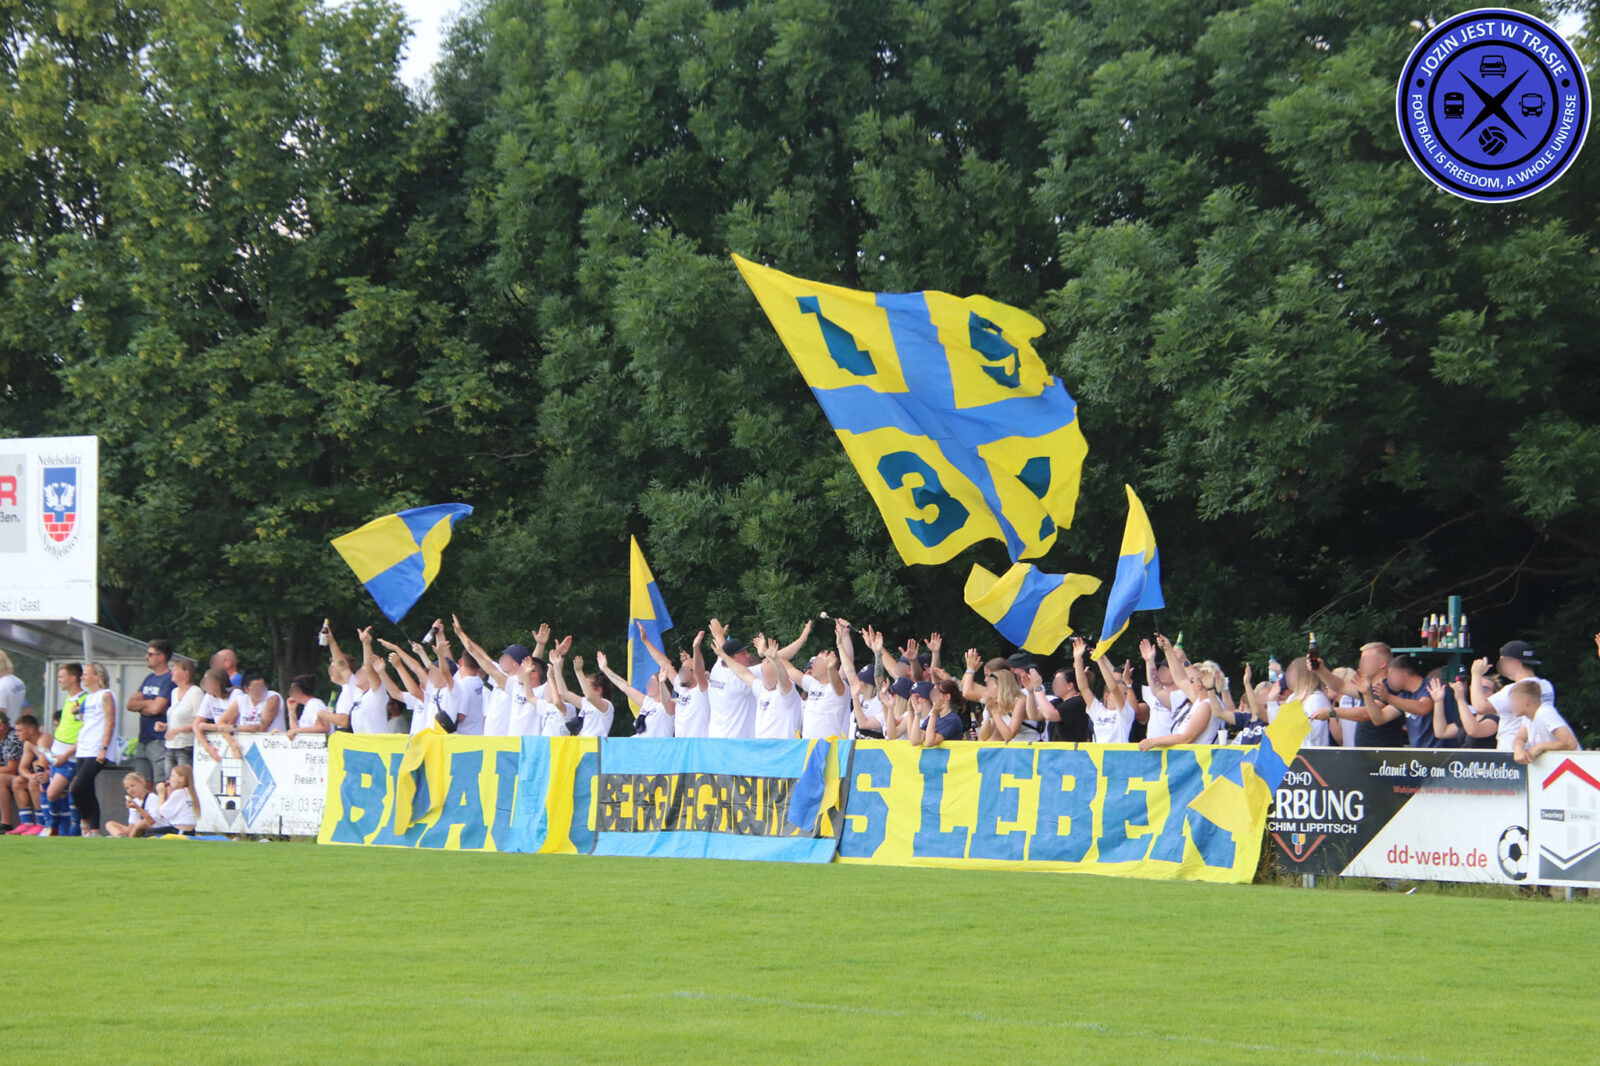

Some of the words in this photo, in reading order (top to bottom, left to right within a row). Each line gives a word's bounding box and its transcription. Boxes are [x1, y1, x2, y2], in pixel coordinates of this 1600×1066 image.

[876, 450, 971, 549] 3
[19, 597, 41, 612] Gast
[1410, 759, 1428, 778] Sie
[1430, 766, 1446, 778] am
[912, 748, 1247, 869] LEBEN
[1267, 788, 1365, 822] RBUNG
[1300, 822, 1358, 834] LIPPITSCH
[1387, 844, 1488, 868] dd-werb.de
